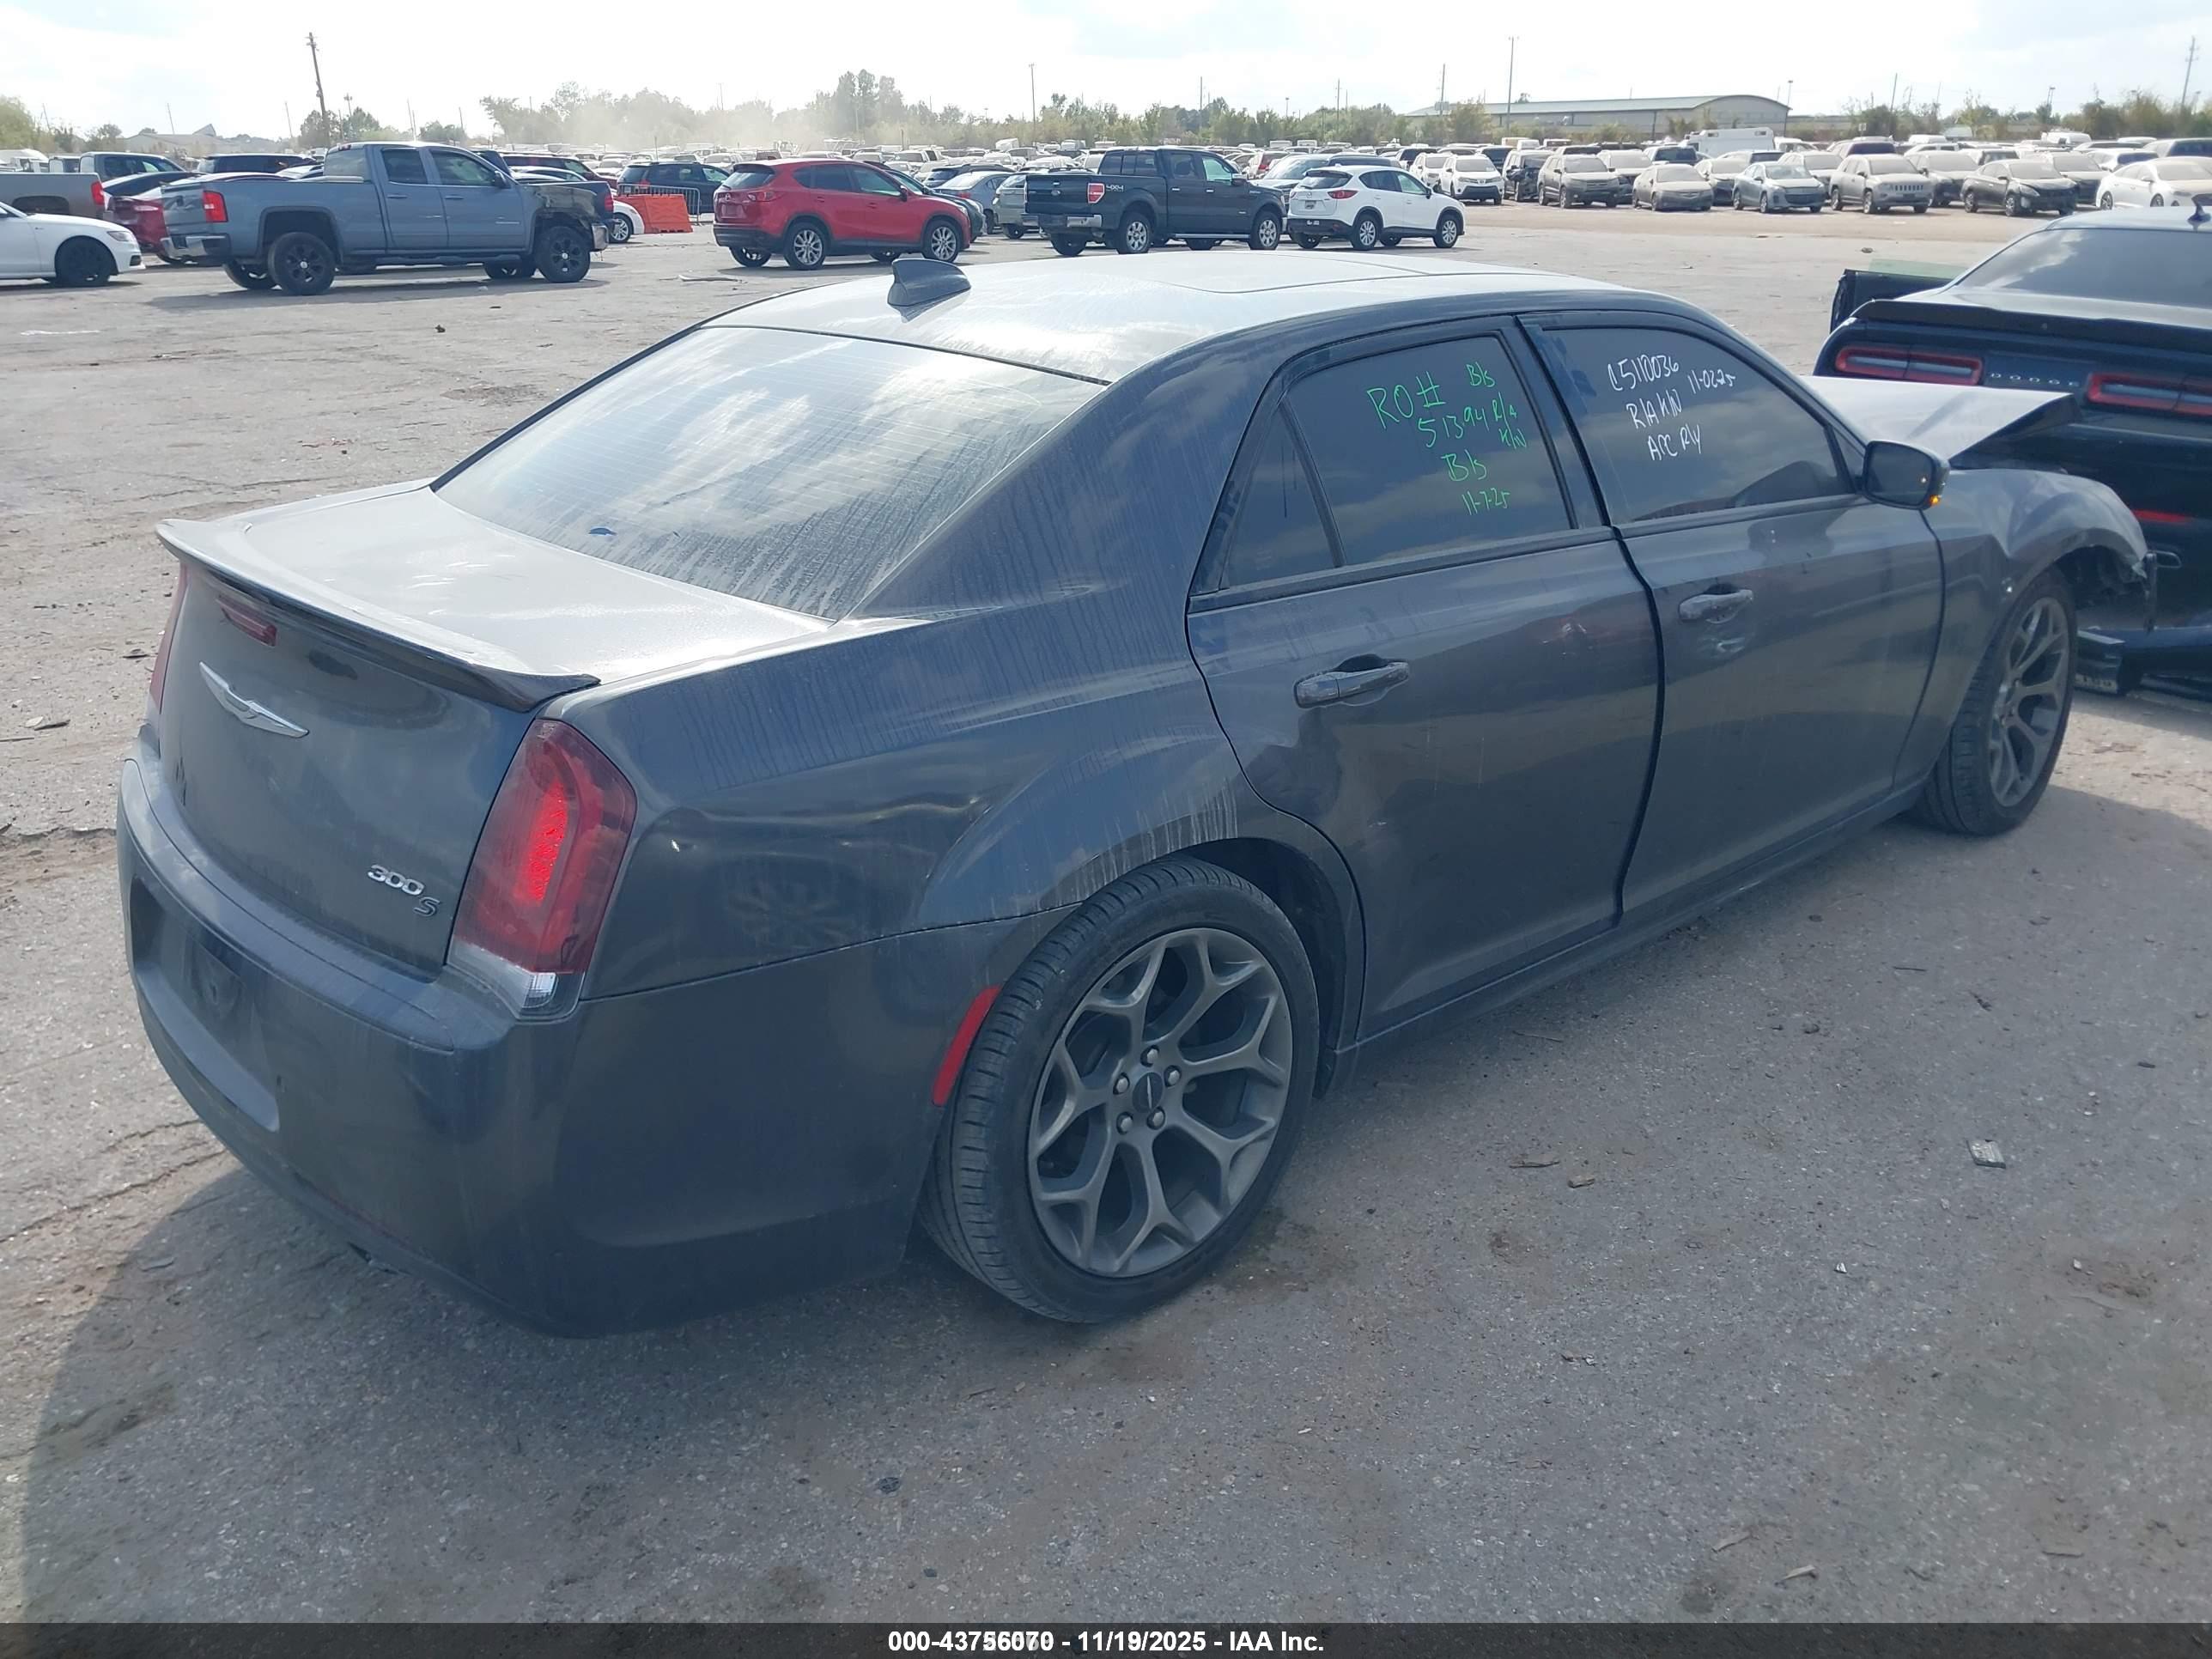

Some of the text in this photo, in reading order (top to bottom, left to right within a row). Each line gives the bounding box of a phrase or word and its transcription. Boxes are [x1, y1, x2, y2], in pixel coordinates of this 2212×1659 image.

[1990, 373, 2080, 387] DODGE
[368, 864, 441, 917] 300 S
